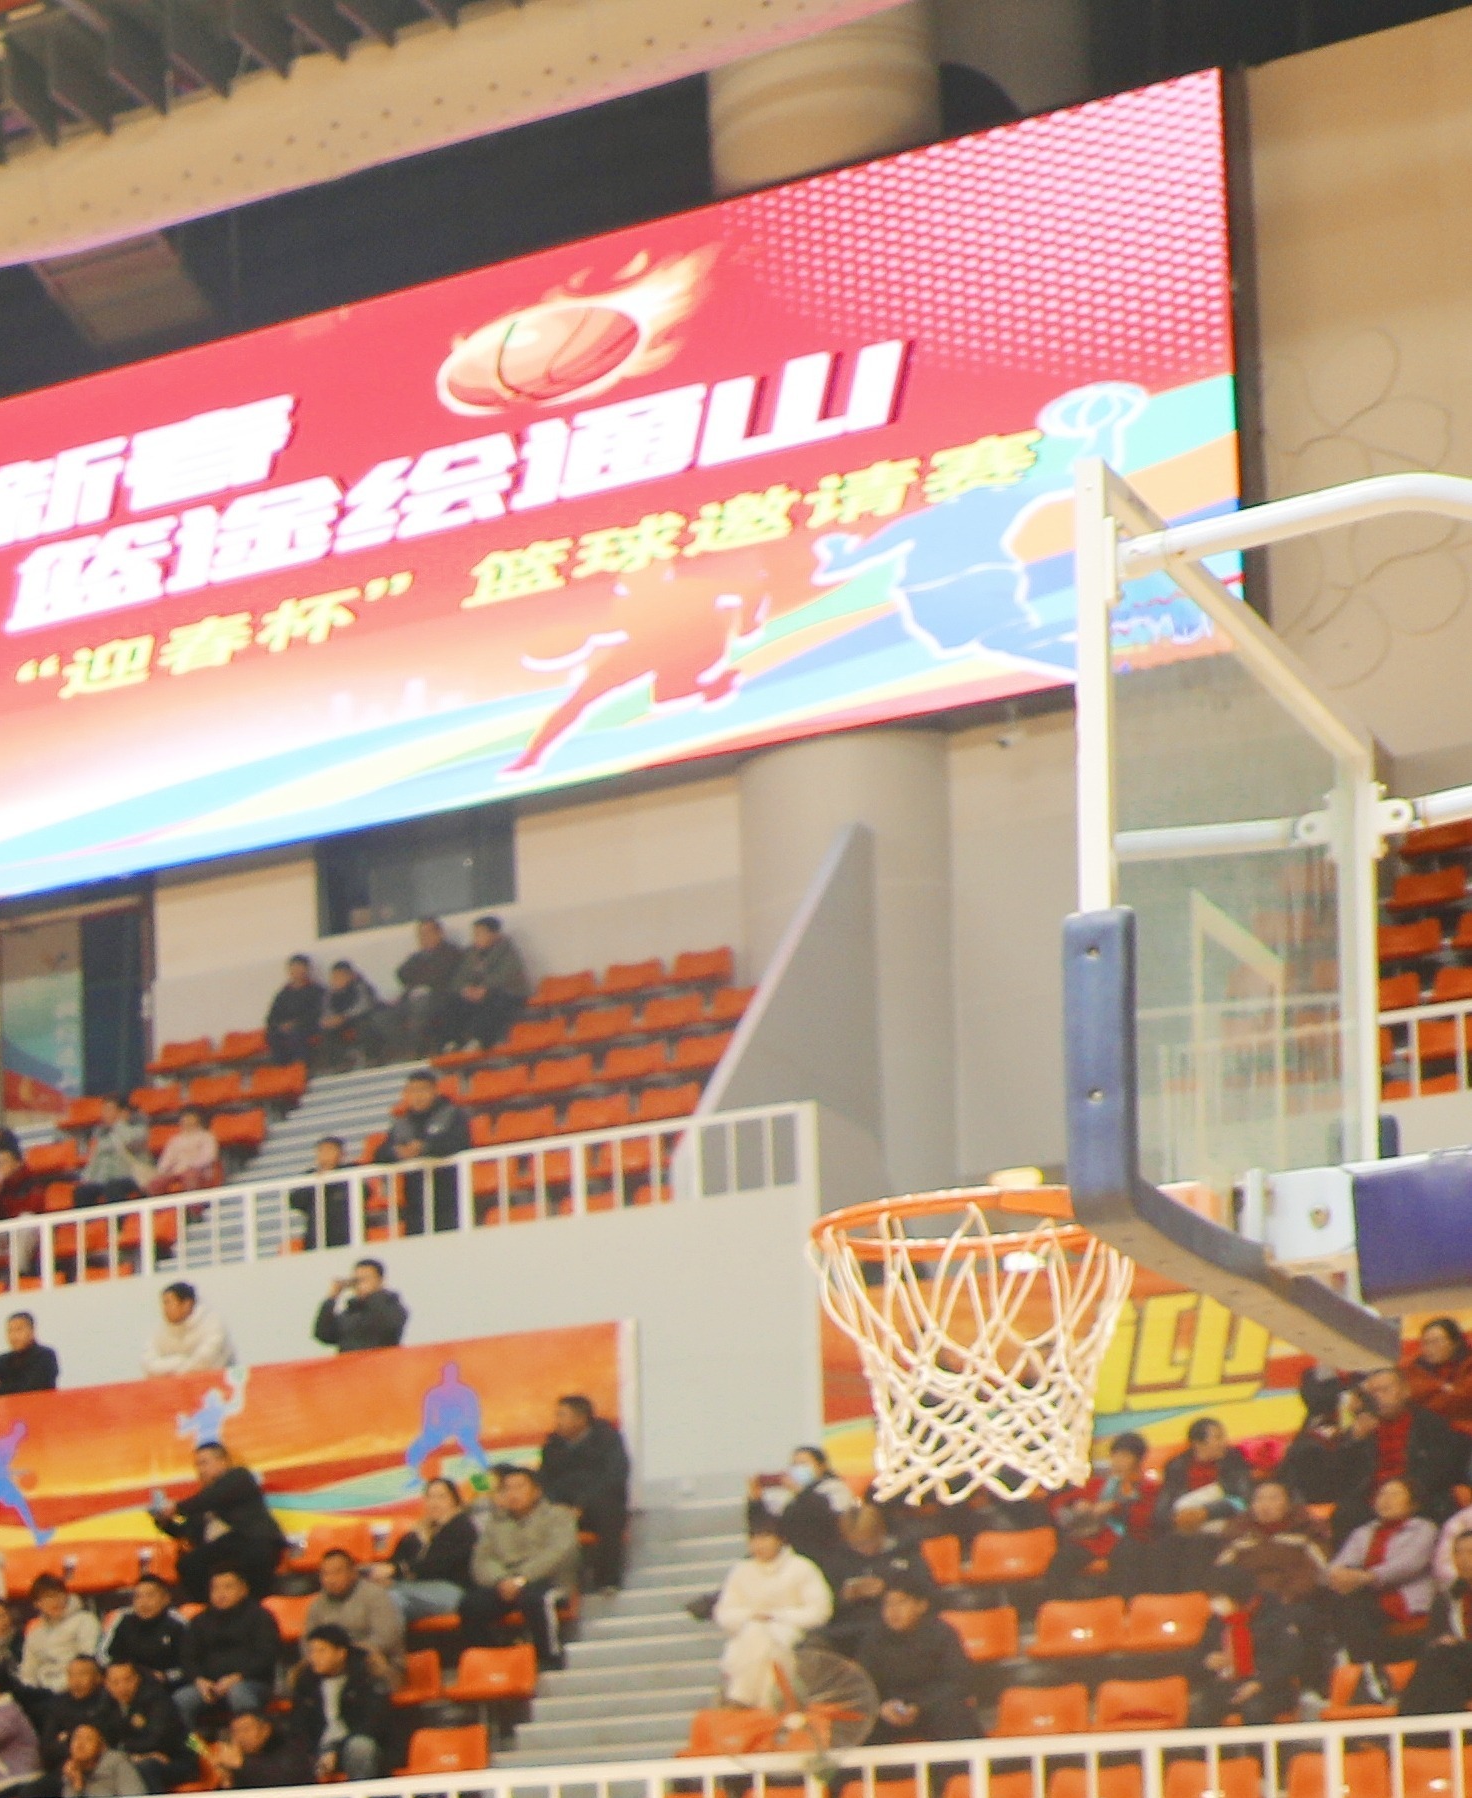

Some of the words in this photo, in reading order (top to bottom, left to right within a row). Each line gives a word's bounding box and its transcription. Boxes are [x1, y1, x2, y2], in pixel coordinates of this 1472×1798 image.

[460, 431, 1048, 608] 篮球邀请赛
